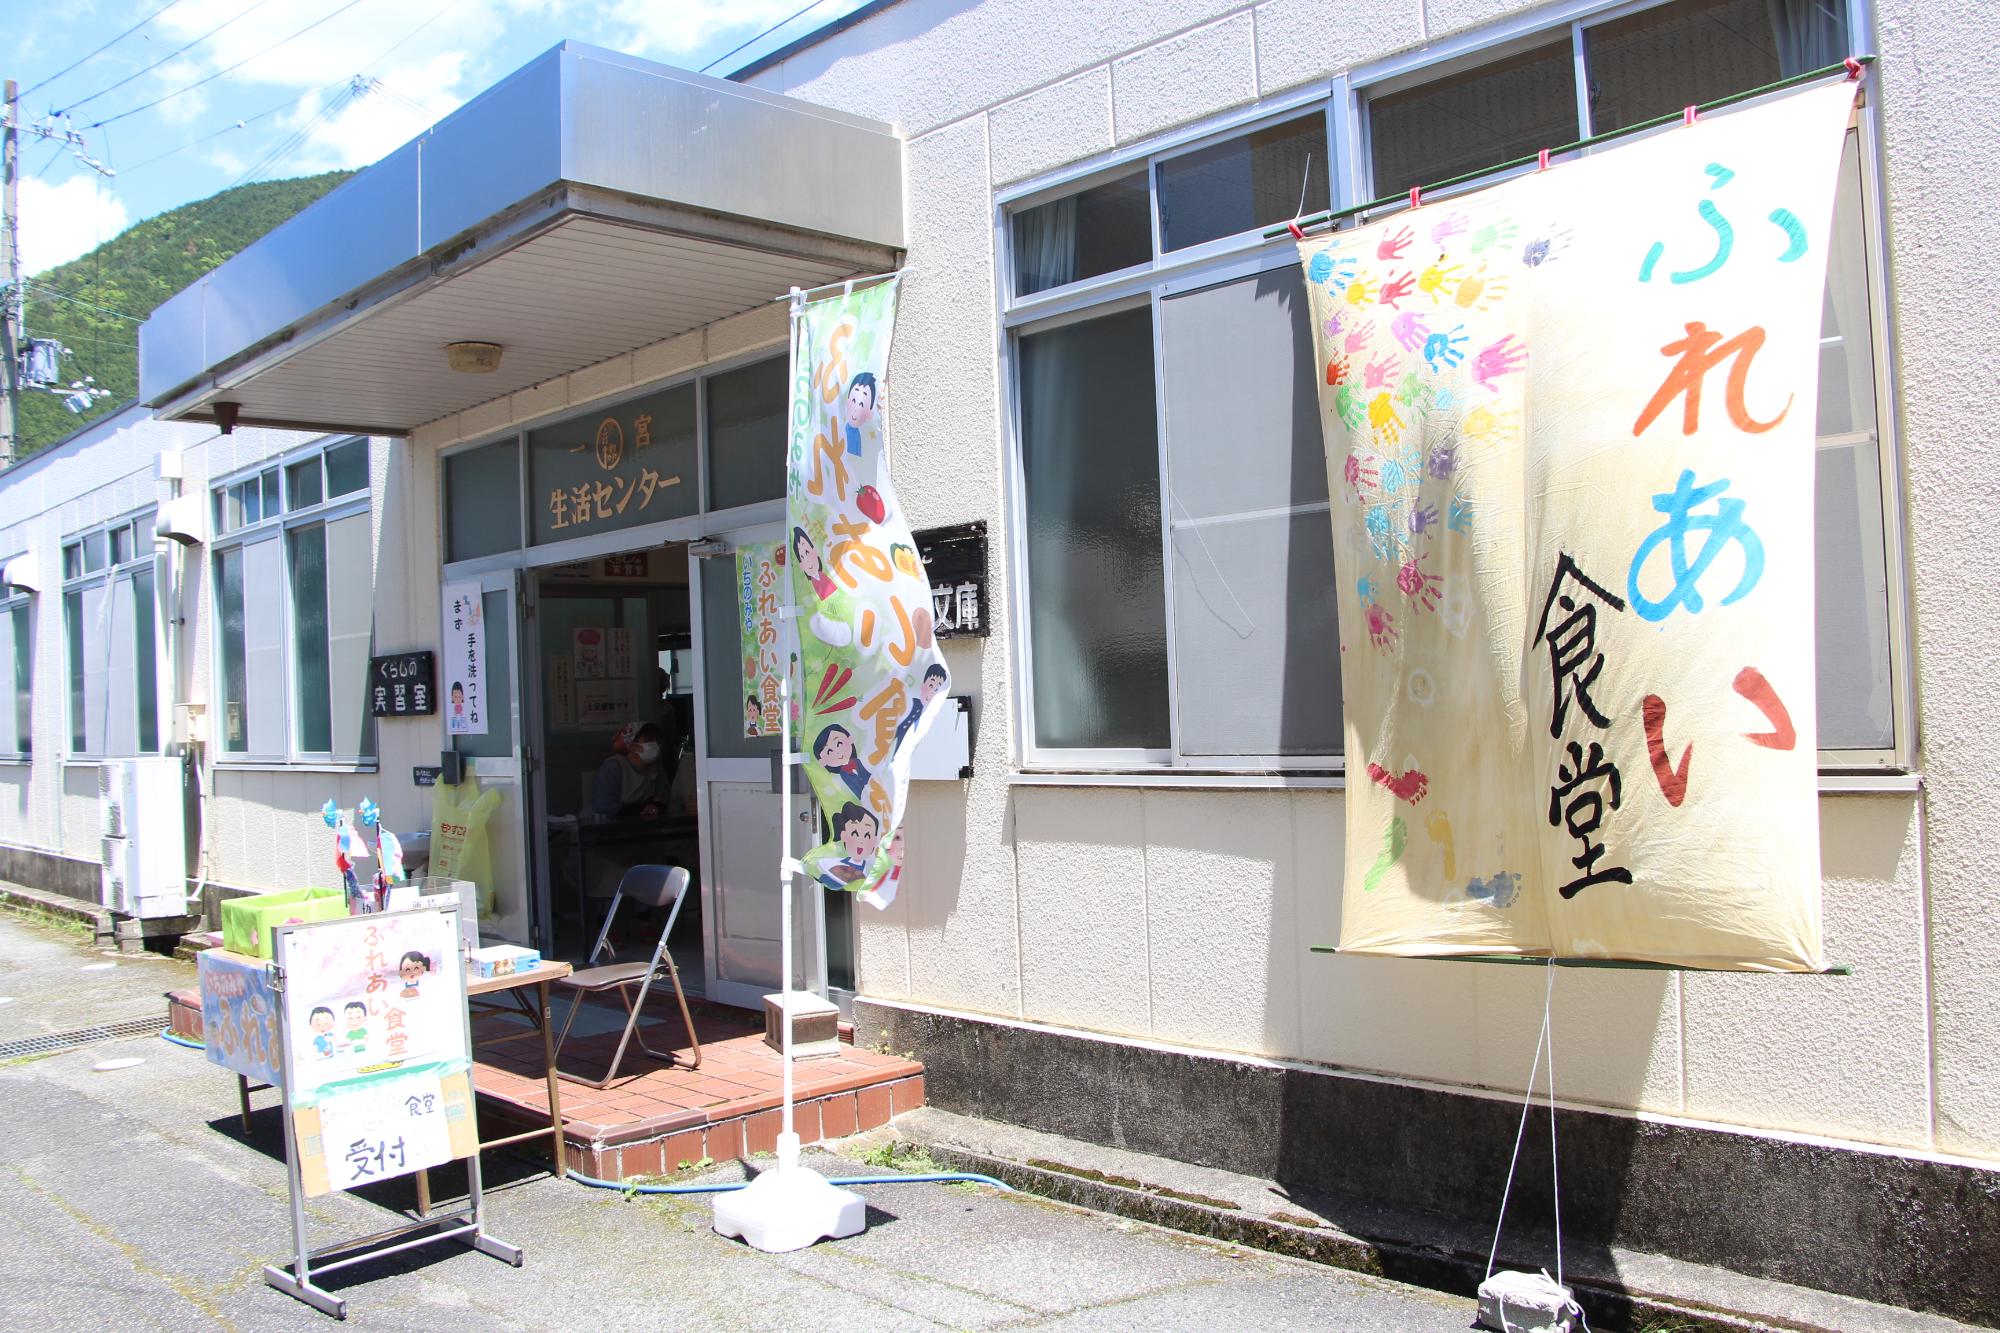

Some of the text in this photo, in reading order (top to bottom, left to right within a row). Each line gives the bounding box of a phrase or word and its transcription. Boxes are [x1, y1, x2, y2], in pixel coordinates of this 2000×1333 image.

[634, 414, 652, 448] 宮
[549, 467, 680, 529] 生活センター
[1626, 161, 1809, 808] ふれあい
[453, 599, 463, 632] まず
[742, 555, 753, 633] いちのみや
[380, 661, 417, 678] くらしの
[757, 561, 782, 734] ふれあい食堂
[374, 683, 427, 712] 実習室
[1531, 549, 1634, 902] 食堂
[363, 925, 389, 1017] ふれあい
[384, 1007, 409, 1057] 食堂
[404, 1092, 436, 1117] 食堂
[345, 1135, 406, 1181] 受付
